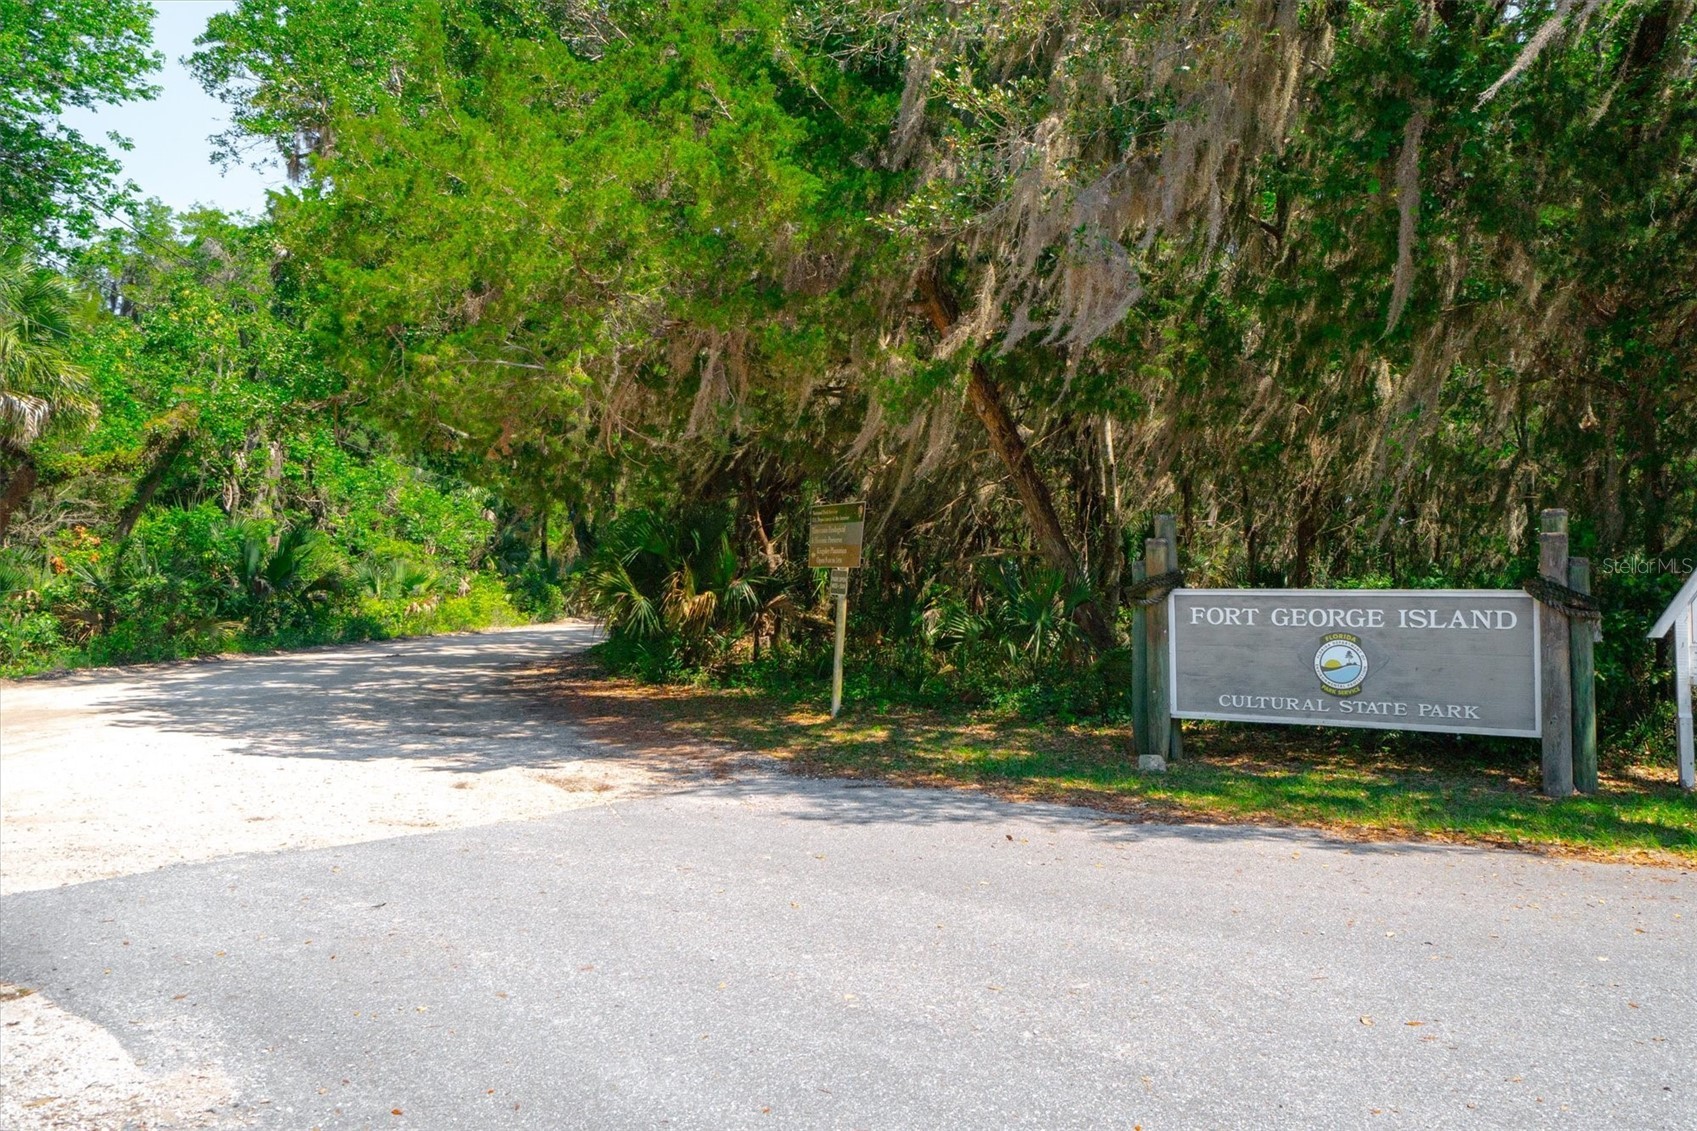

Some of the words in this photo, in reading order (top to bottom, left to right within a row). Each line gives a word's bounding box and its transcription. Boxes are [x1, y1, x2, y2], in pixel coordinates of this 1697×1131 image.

[1190, 606, 1260, 626] FORT
[1271, 607, 1385, 628] GEORGE
[1398, 609, 1518, 630] ISLAND
[1325, 633, 1356, 642] FLORIDA
[1321, 684, 1336, 694] PARK
[1337, 686, 1360, 696] SERVICE
[1218, 694, 1331, 713] CULTURAL
[1339, 700, 1408, 716] STATE
[1418, 704, 1480, 720] PARK
